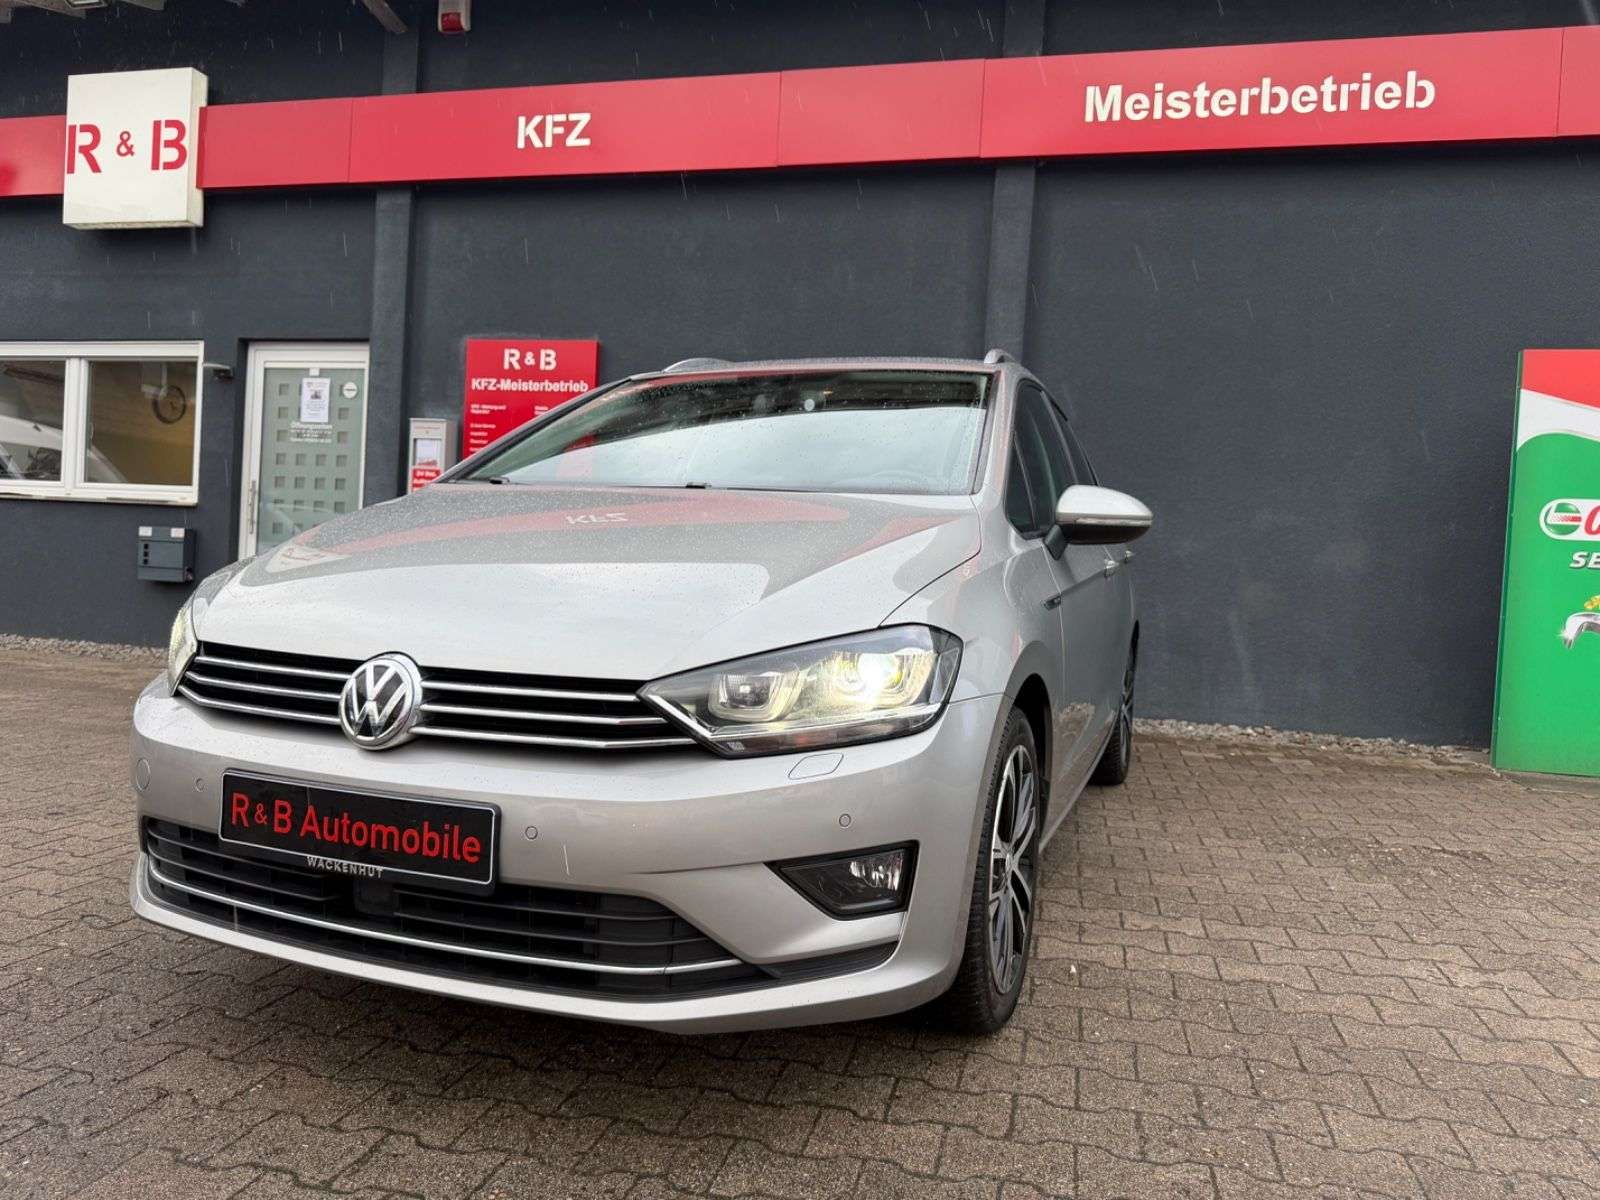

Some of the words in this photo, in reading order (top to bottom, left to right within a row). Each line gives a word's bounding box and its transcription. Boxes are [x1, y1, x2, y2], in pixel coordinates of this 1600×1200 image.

[1084, 70, 1437, 123] Meisterbetrieb
[66, 123, 102, 174] R
[115, 130, 135, 157] &
[150, 119, 188, 171] B
[516, 112, 592, 149] KFZ
[503, 348, 521, 370] R
[523, 351, 536, 366] &
[539, 349, 557, 371] B
[470, 378, 589, 393] KFZ-Meisterbetrieb
[230, 792, 250, 828] R
[253, 802, 269, 826] &
[272, 799, 293, 835] B
[299, 804, 482, 864] Automobile
[306, 855, 385, 879] WACKENHUT
